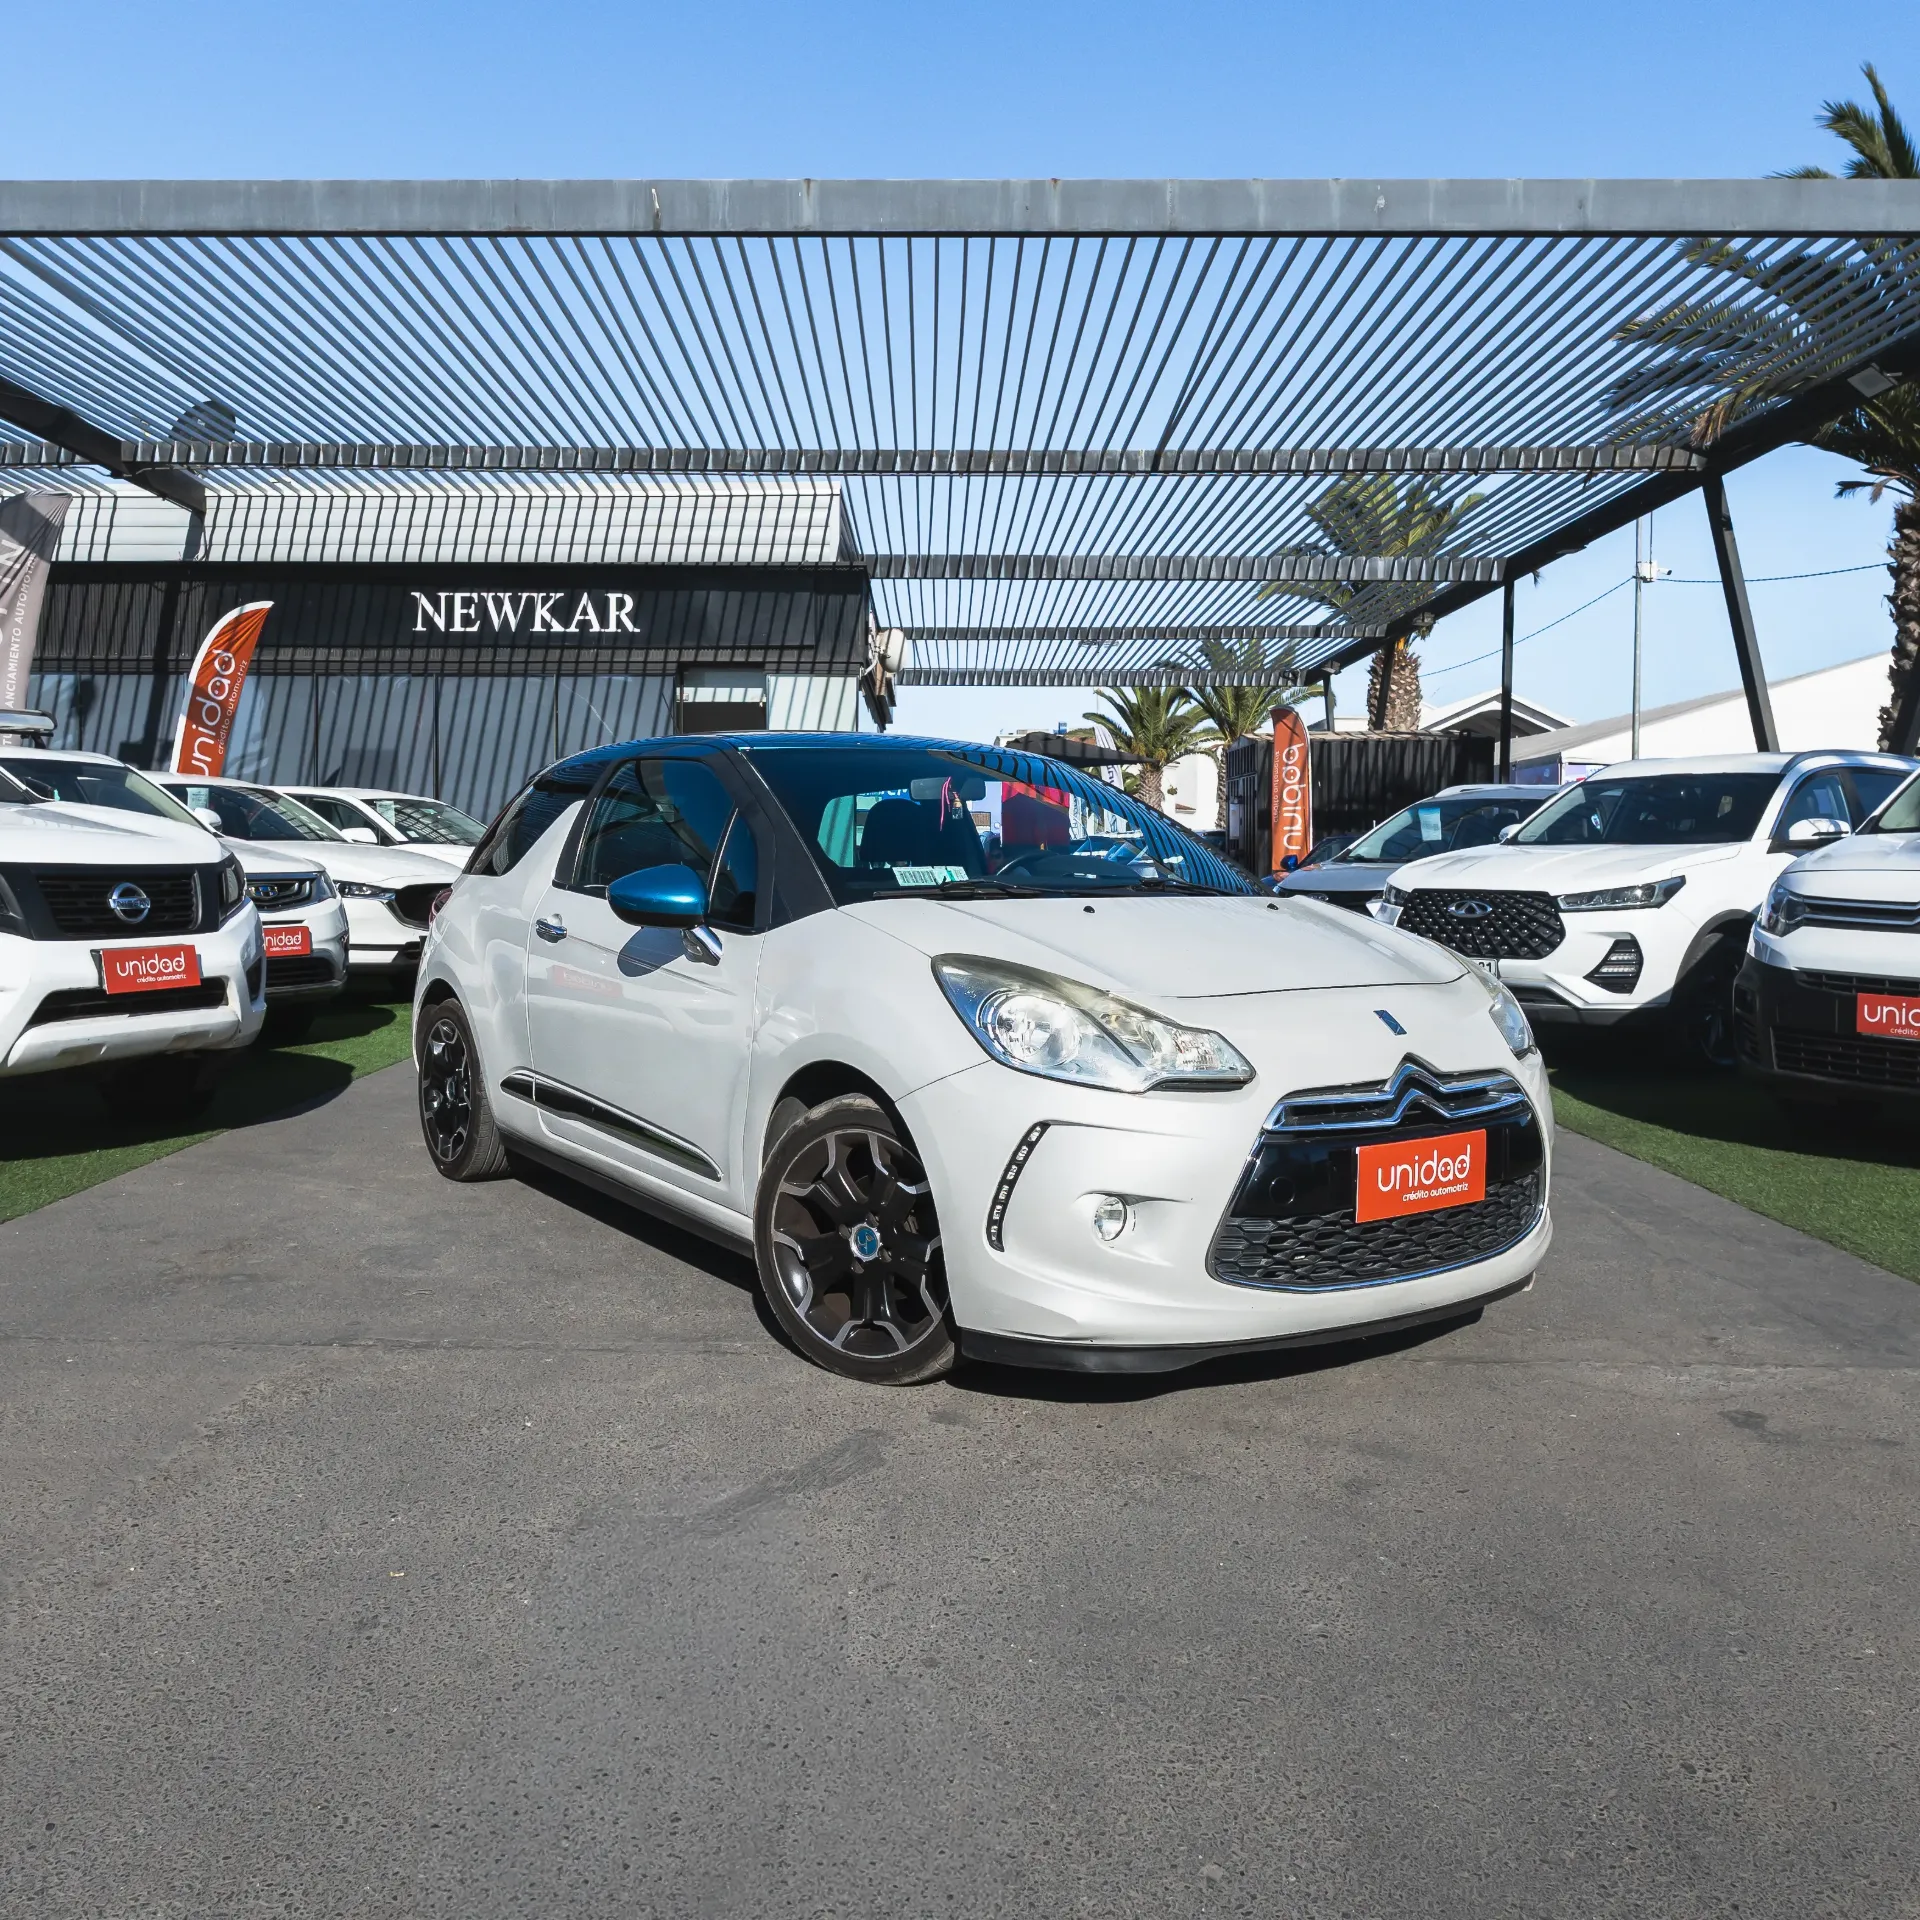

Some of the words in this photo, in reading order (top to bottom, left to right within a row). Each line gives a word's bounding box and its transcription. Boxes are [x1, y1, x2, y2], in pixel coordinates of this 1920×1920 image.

[410, 591, 641, 633] NEWKAR
[4, 627, 22, 709] ANCIAMIENTO
[191, 648, 236, 777] unidad
[218, 717, 231, 755] crédito
[226, 659, 248, 717] automotriz
[263, 930, 302, 949] nidad
[116, 950, 186, 977] unidad
[1890, 1026, 1919, 1036] crédito
[1377, 1143, 1471, 1192] unidad
[1402, 1188, 1429, 1202] crédito
[1430, 1181, 1469, 1197] automotriz
